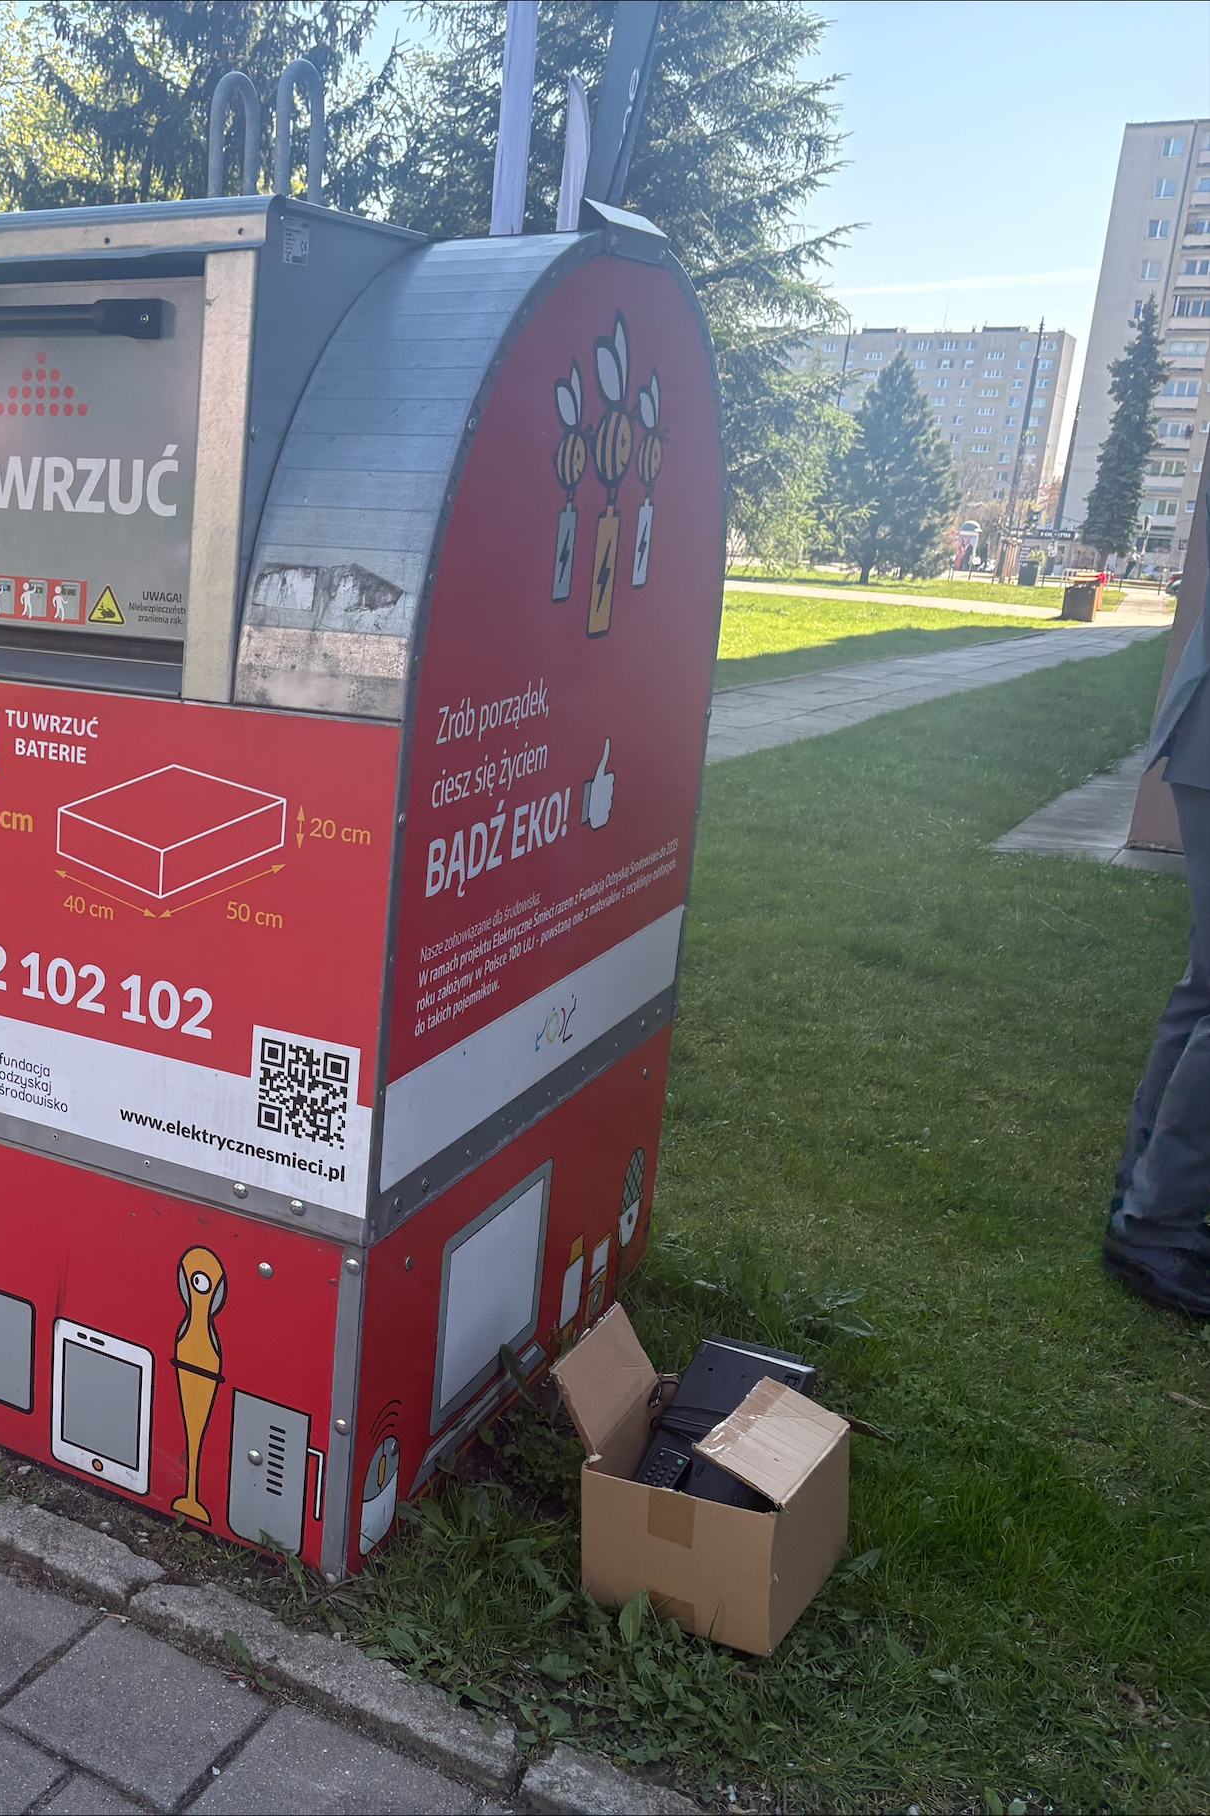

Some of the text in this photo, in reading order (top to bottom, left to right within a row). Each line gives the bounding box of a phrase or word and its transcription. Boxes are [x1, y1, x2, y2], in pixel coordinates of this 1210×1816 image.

[137, 614, 184, 626] zranienia rąk.
[142, 590, 182, 603] UWAGA!
[5, 709, 99, 738] TU WRZUĆ
[435, 677, 551, 745] Zrób porządek,
[15, 738, 86, 764] BATERIE
[431, 741, 548, 809] ciesz się życiem
[0, 811, 34, 833] cm
[309, 818, 371, 845] 20 cm
[425, 786, 571, 898] BĄDŹ EKO!
[63, 895, 114, 920] 40 cm
[226, 901, 283, 928] 50 cm
[418, 969, 429, 988] W
[430, 953, 459, 983] ramach
[459, 940, 491, 970] projektu
[492, 918, 533, 949] Elektryczne
[533, 903, 555, 927] Śmieci
[555, 896, 574, 917] razem
[574, 893, 579, 905] z
[578, 878, 605, 903] Fundacją
[605, 864, 630, 888] Odzyskaj
[417, 991, 435, 1012] roku
[437, 971, 473, 1001] założymy
[475, 966, 483, 980] w
[484, 953, 507, 976] Polsce
[509, 942, 522, 961] 100
[540, 917, 571, 947] powstaną
[573, 911, 584, 926] one
[589, 889, 621, 916] materiałów
[420, 942, 444, 963] Nasze
[444, 916, 491, 952] zobowiązanie
[492, 908, 503, 928] dla
[20, 952, 106, 1013] 102
[120, 974, 213, 1039] 102
[415, 979, 500, 1036] do takich pojemników.
[119, 1108, 346, 1182] www.elektrycznesmieci.pl
